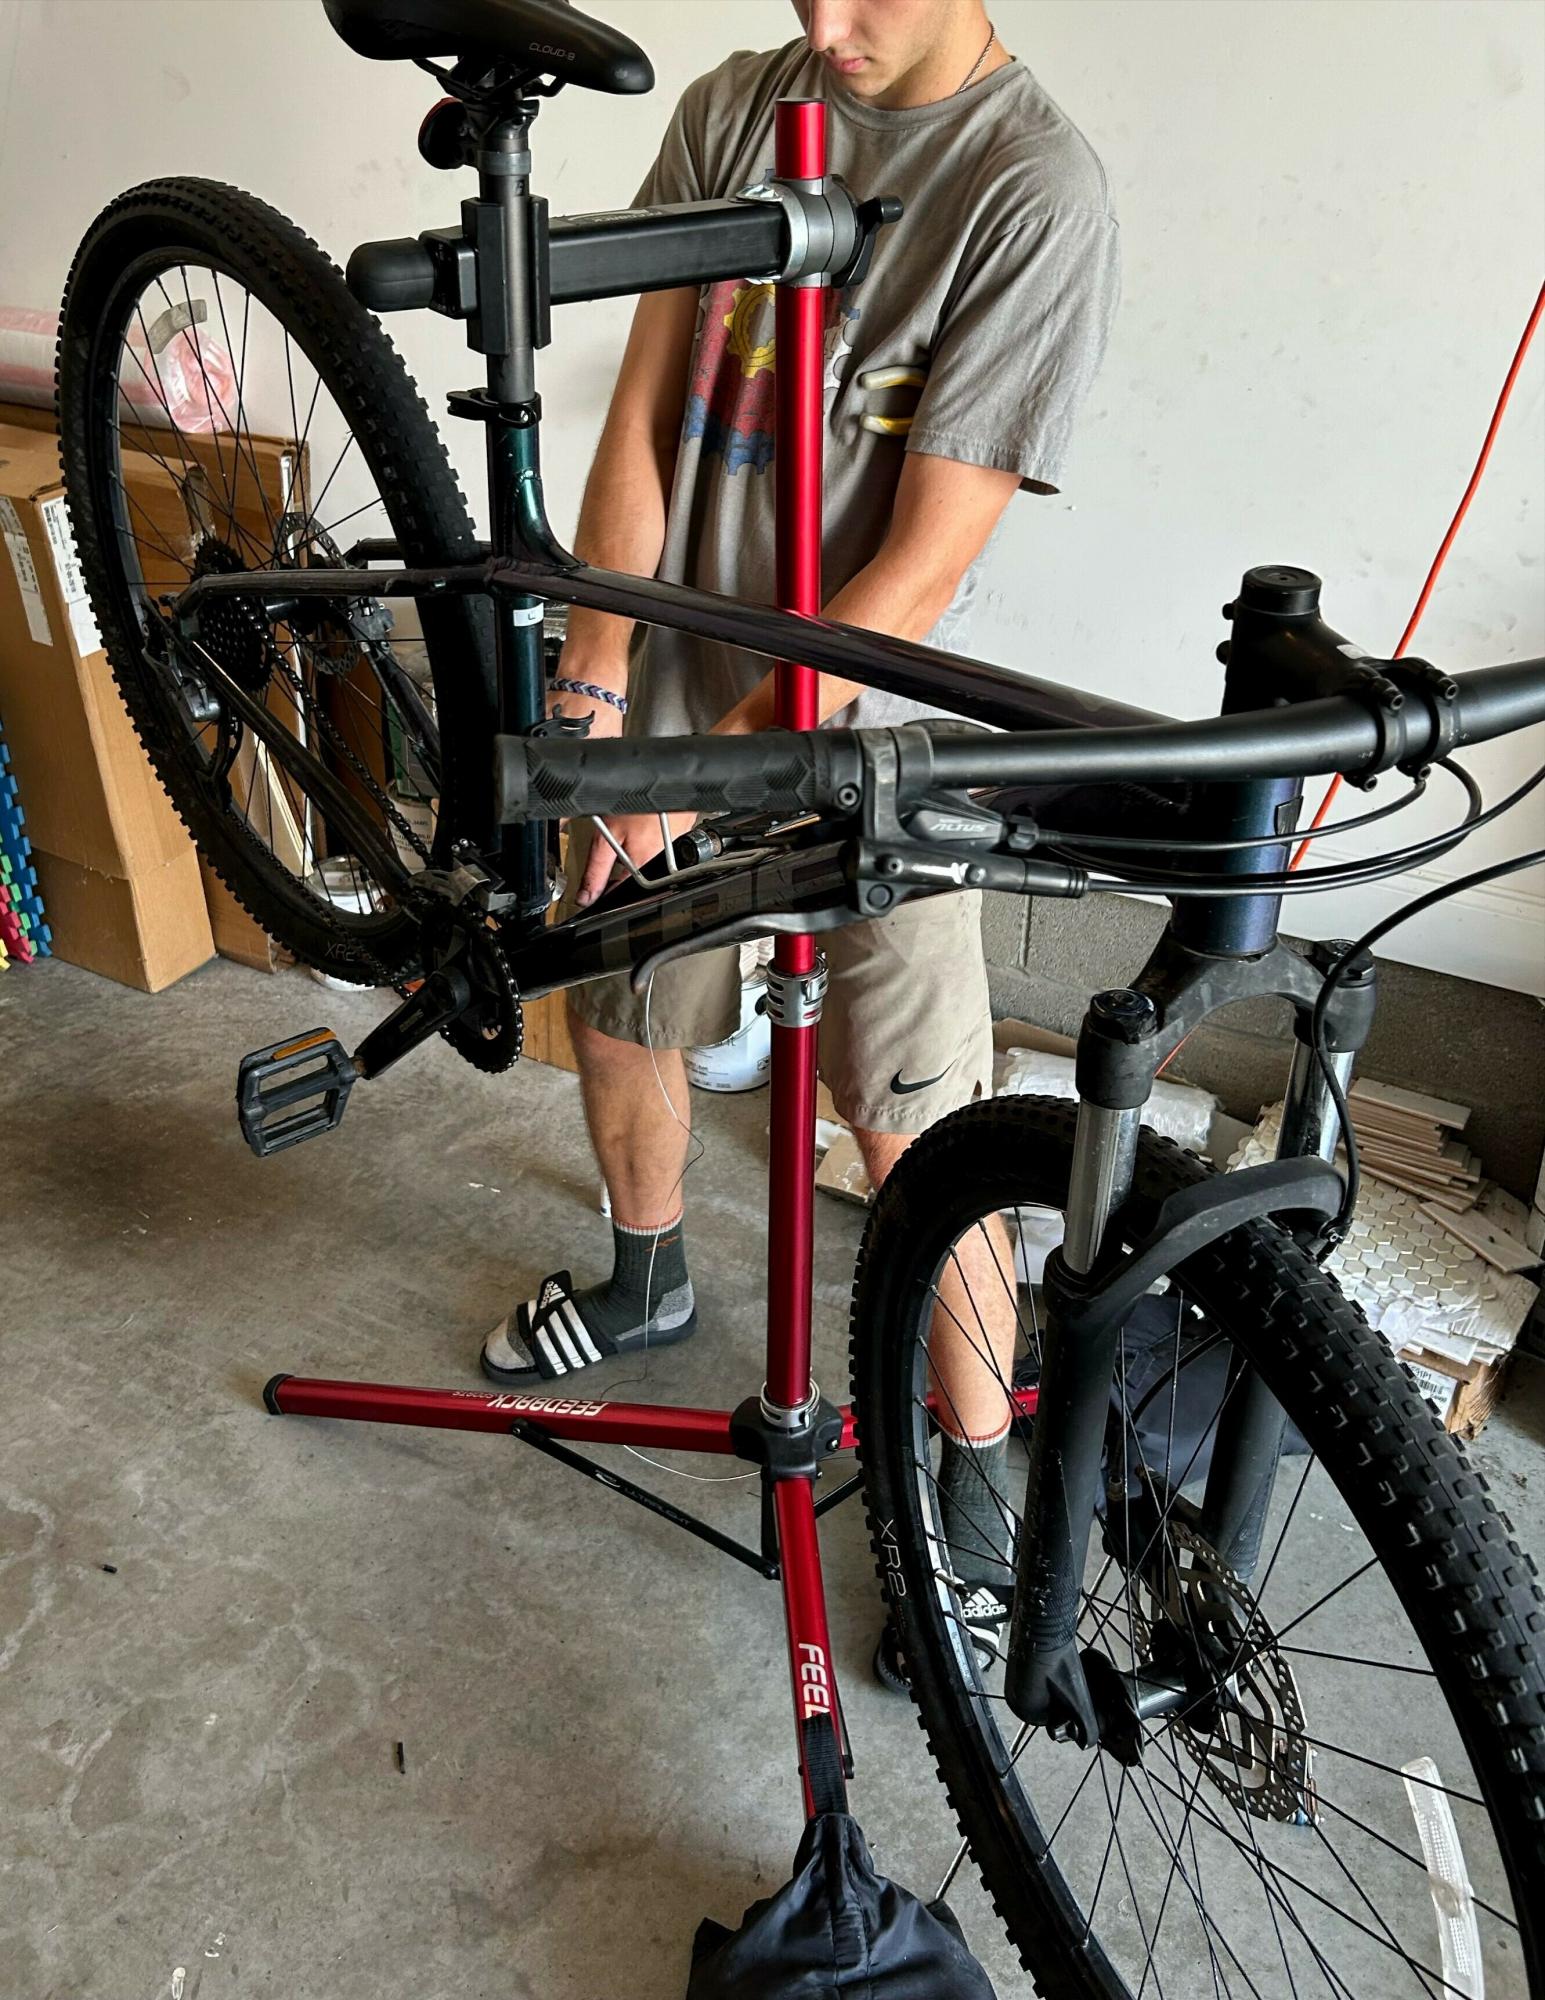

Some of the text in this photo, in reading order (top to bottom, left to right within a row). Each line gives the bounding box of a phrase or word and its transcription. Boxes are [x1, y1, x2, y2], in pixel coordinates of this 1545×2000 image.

[929, 823, 986, 832] ALTUS
[487, 1394, 608, 1416] FEEDBACK
[877, 1518, 907, 1596] XR2
[962, 1603, 1007, 1618] adidas
